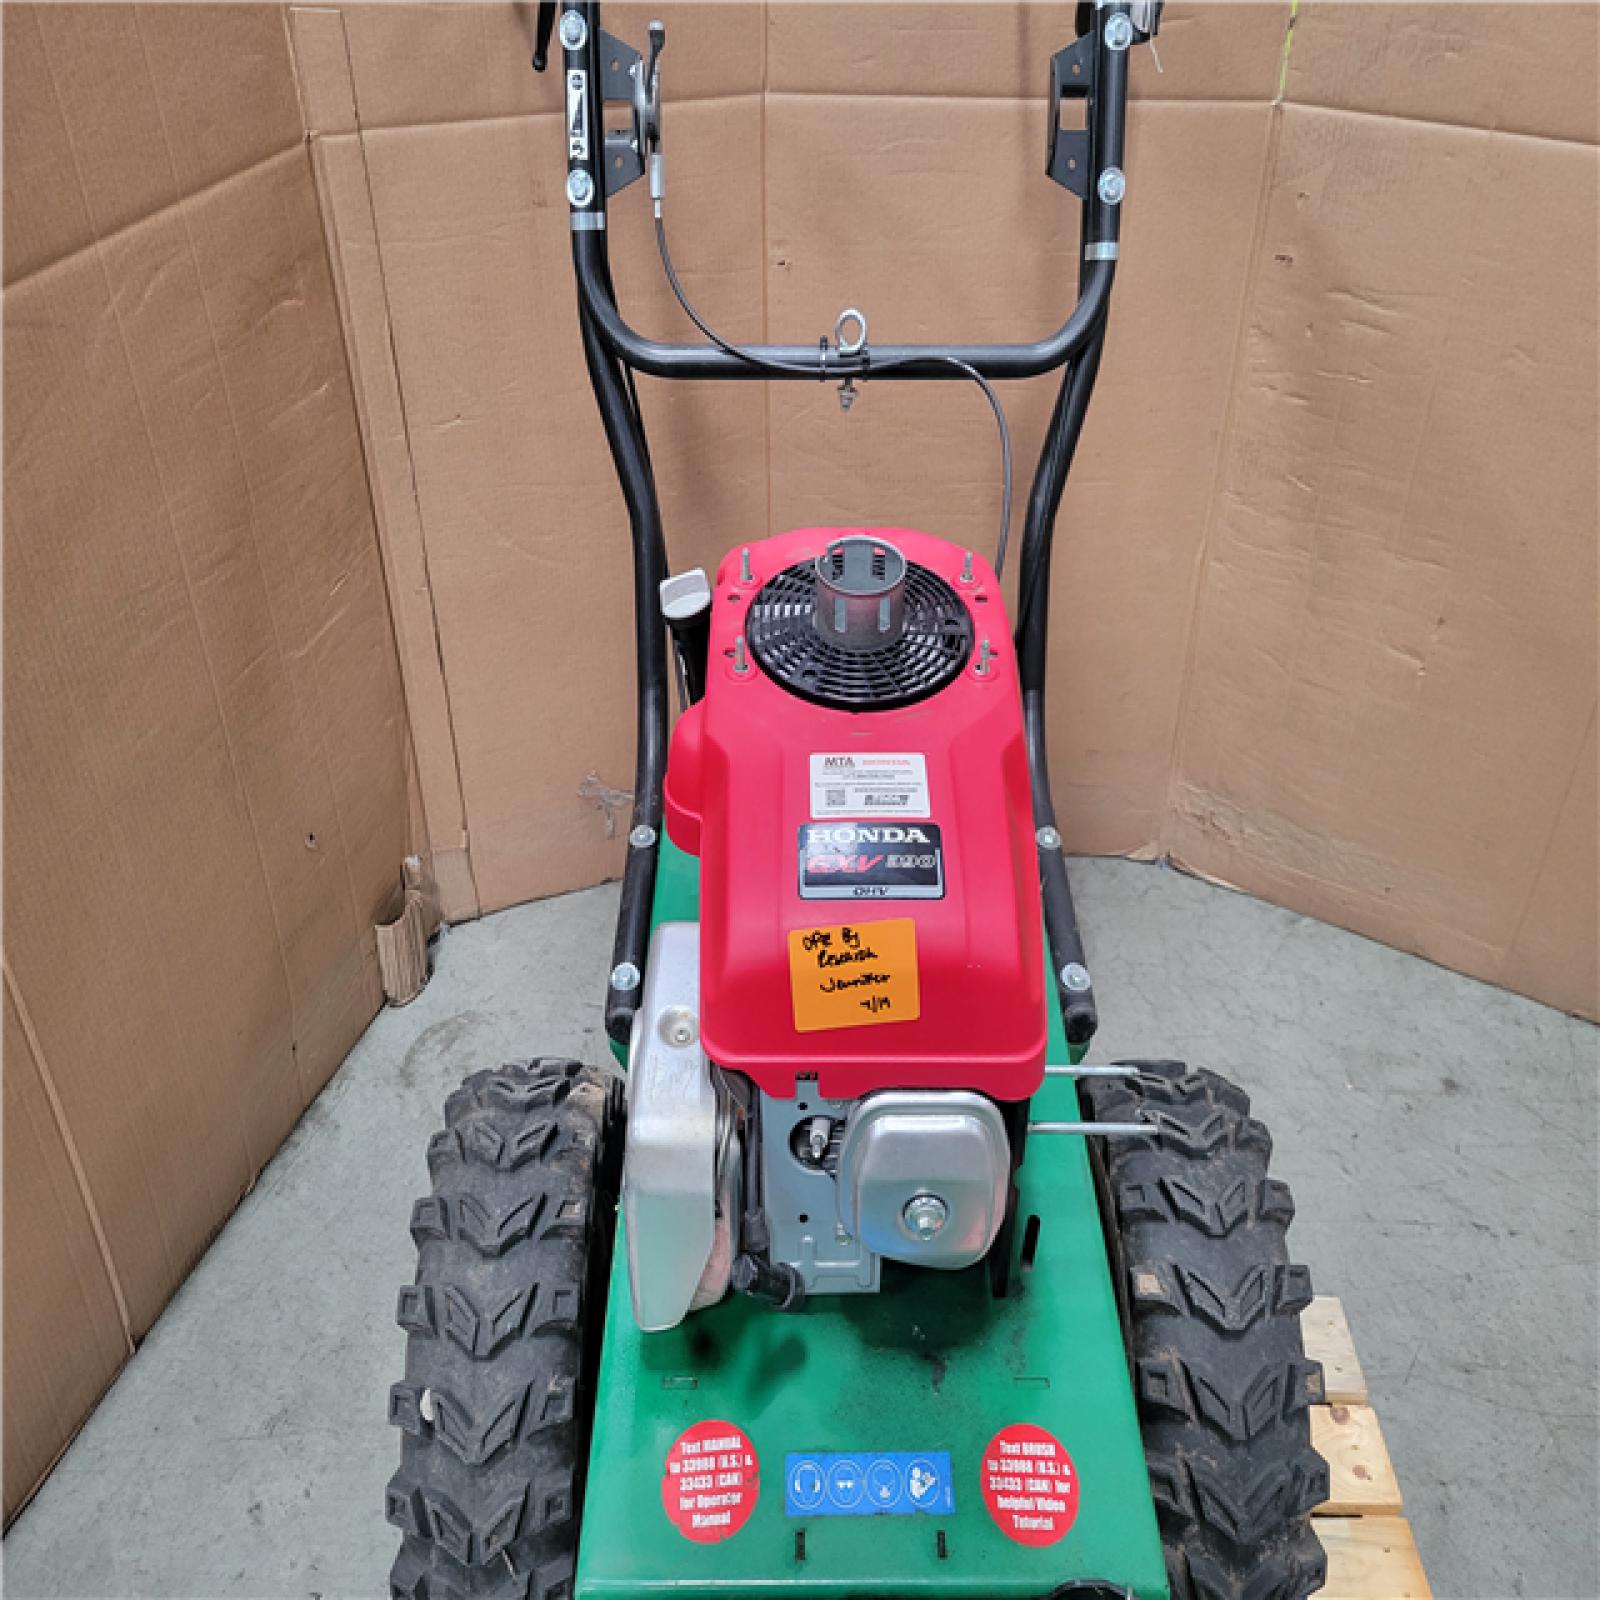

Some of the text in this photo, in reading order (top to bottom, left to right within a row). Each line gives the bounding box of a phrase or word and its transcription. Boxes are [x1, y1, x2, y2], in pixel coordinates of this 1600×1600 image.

[806, 827, 931, 844] HONDA
[806, 853, 885, 874] GXV
[852, 886, 890, 897] OHV
[842, 927, 861, 949] By
[680, 1435, 742, 1455] Text MANUAL
[1000, 1440, 1020, 1455] Text
[670, 1462, 680, 1473] to
[744, 1454, 753, 1466] &
[987, 1460, 998, 1471] to
[1062, 1464, 1071, 1476] &
[1054, 1480, 1071, 1494] for
[680, 1491, 742, 1511] for Operator
[997, 1495, 1066, 1512] helpful Video
[691, 1510, 731, 1529] Manual
[1012, 1514, 1054, 1530] Tutorial
